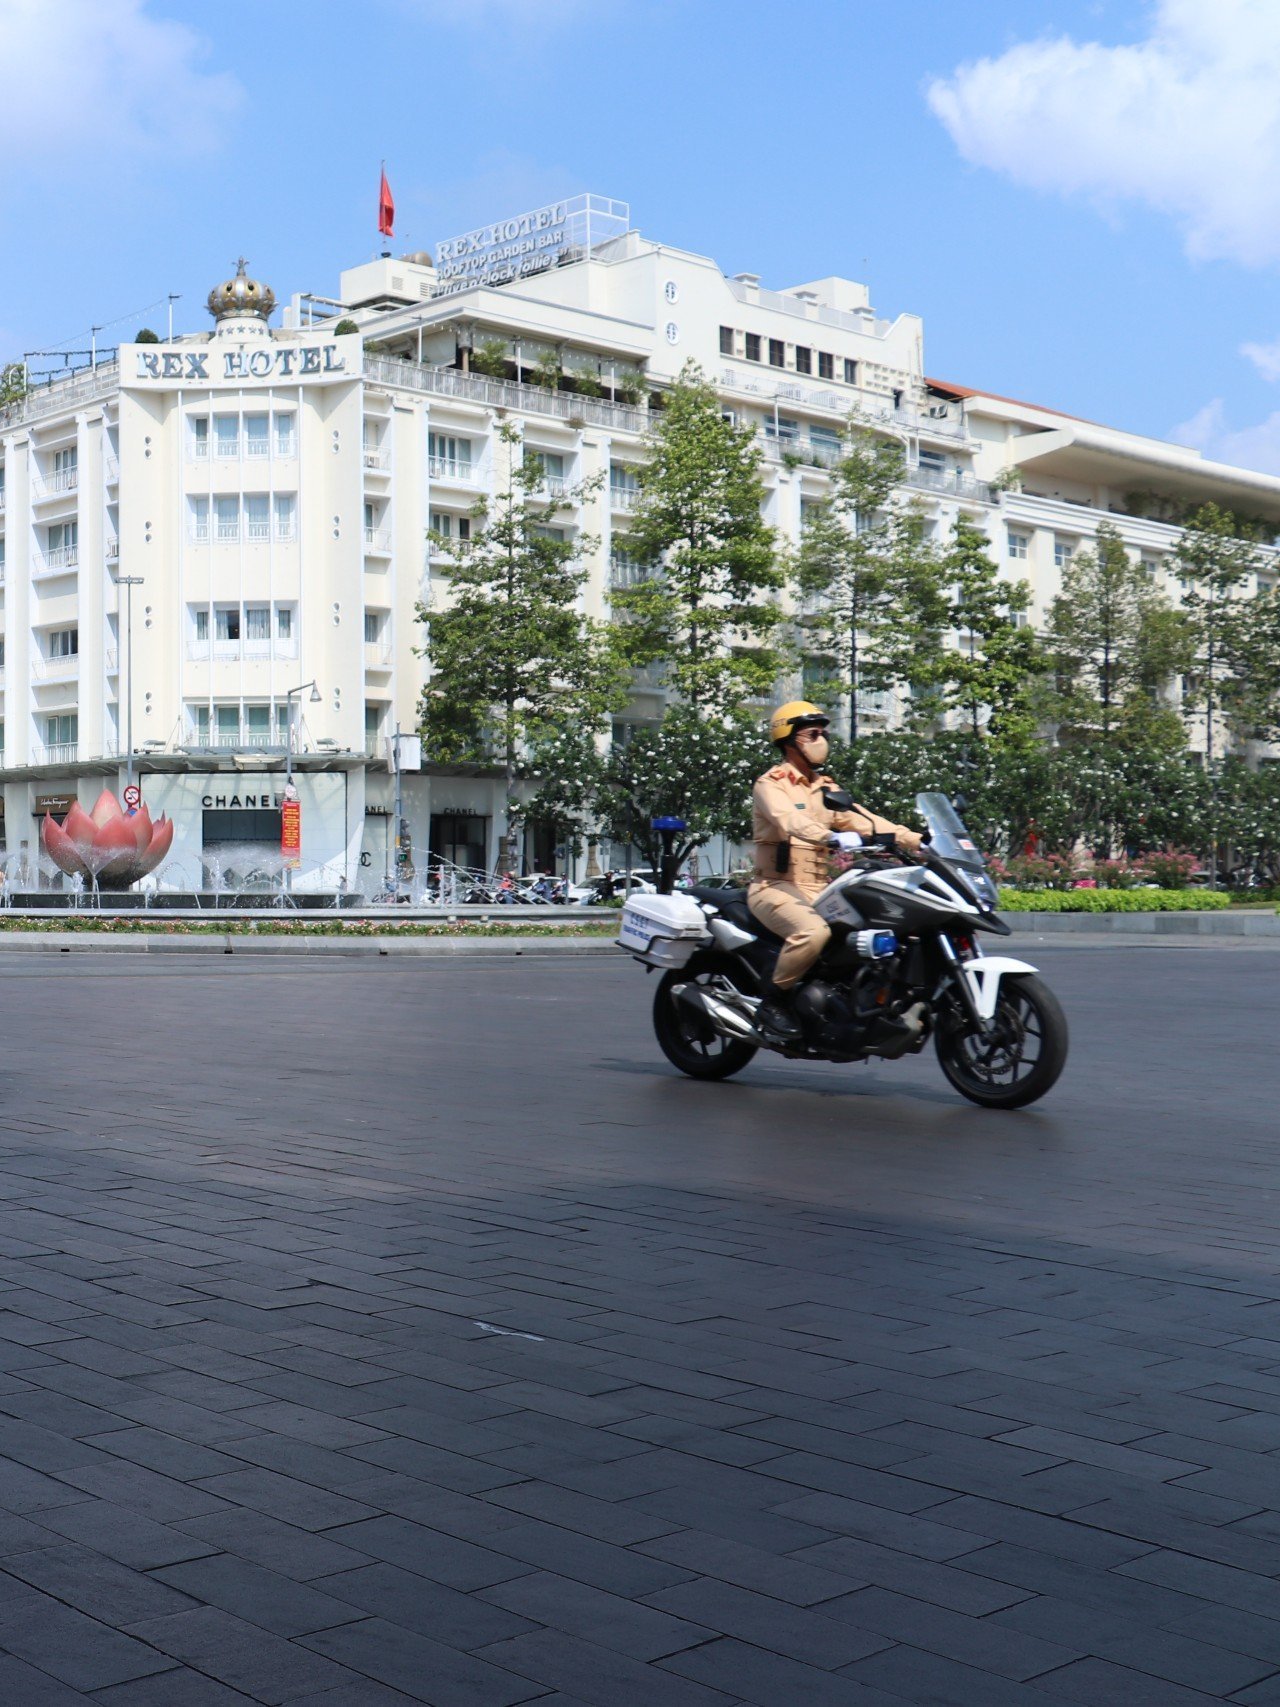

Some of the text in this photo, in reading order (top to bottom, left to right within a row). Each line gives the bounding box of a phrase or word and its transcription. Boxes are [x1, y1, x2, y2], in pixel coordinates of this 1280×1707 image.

[435, 205, 568, 264] REX HOTEL
[436, 231, 564, 281] ROOFTOP GARDEN BAR
[136, 344, 346, 379] REX HOTEL
[202, 794, 281, 808] CHANEL
[365, 805, 388, 815] ANEL
[443, 807, 478, 817] CHANEL
